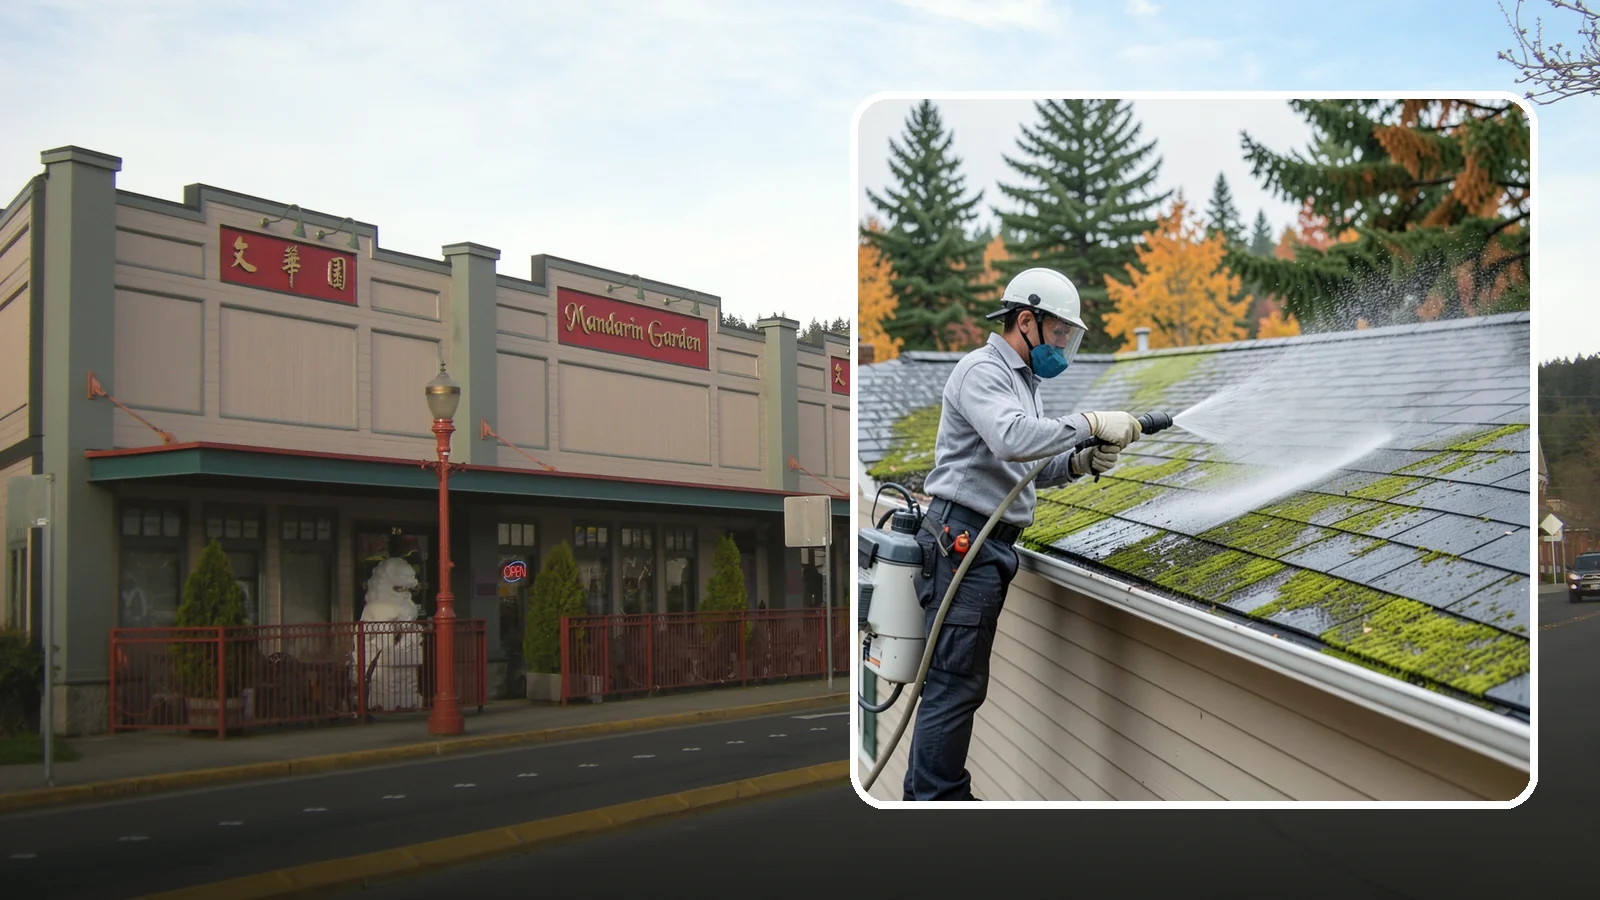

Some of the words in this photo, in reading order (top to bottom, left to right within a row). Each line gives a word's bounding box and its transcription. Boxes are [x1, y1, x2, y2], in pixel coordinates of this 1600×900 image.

[231, 235, 347, 292] 文華園
[565, 302, 643, 341] Mandarin
[648, 320, 701, 352] Garden
[503, 565, 527, 578] OPEN
